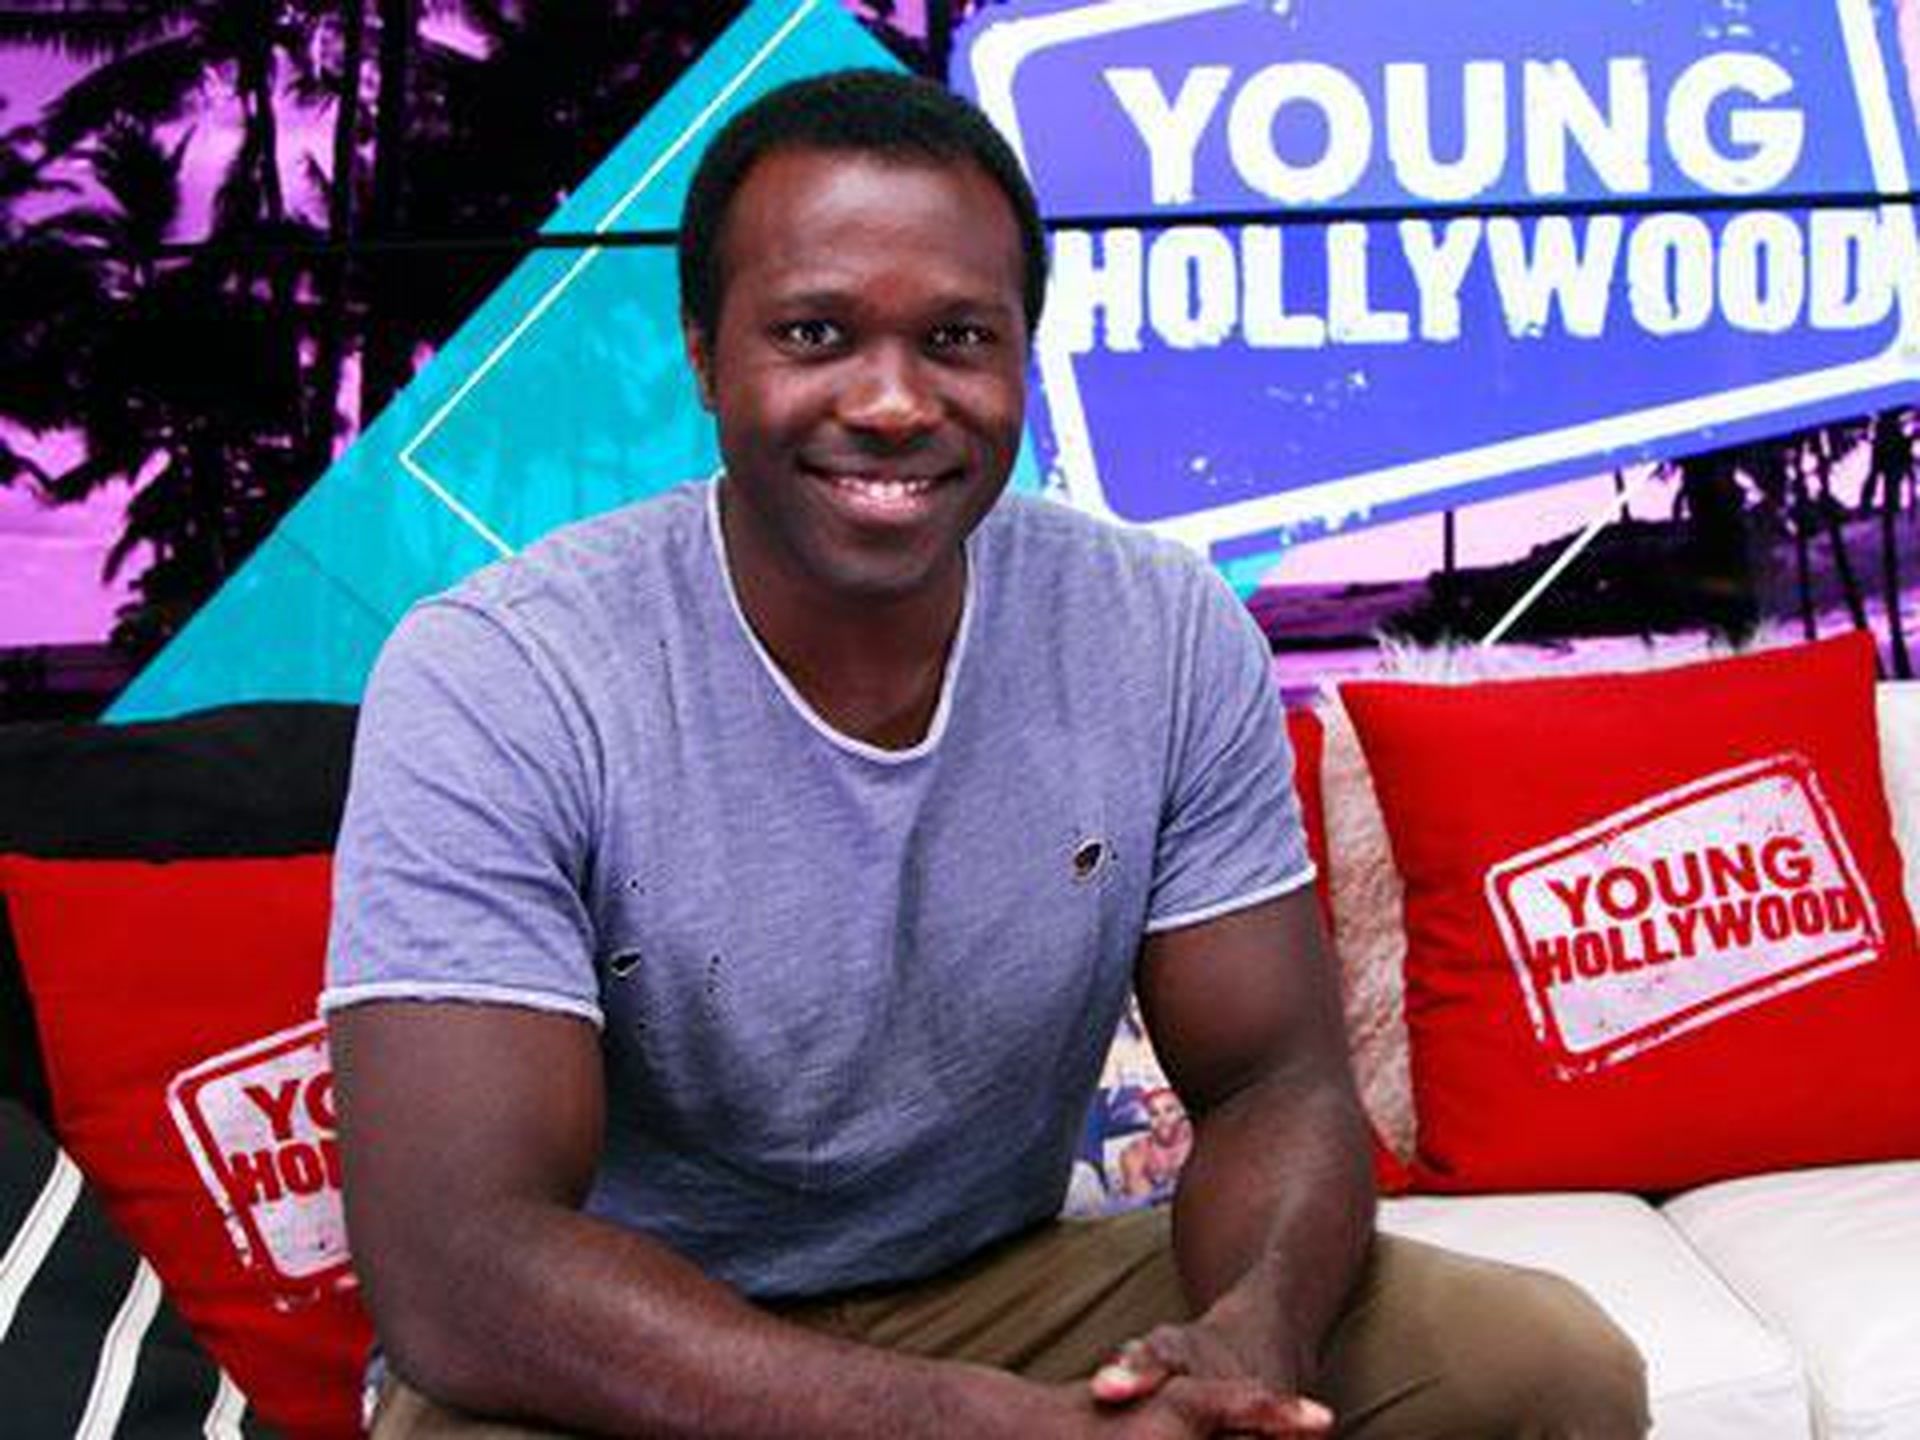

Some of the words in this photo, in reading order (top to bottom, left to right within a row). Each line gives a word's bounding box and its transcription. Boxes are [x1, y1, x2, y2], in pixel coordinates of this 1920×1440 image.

[1103, 51, 1805, 204] YOUNG
[1050, 209, 1903, 352] HOLLYWOOD
[1534, 889, 1861, 987] HOLLYWOOD
[1547, 836, 1815, 928] YOUNG
